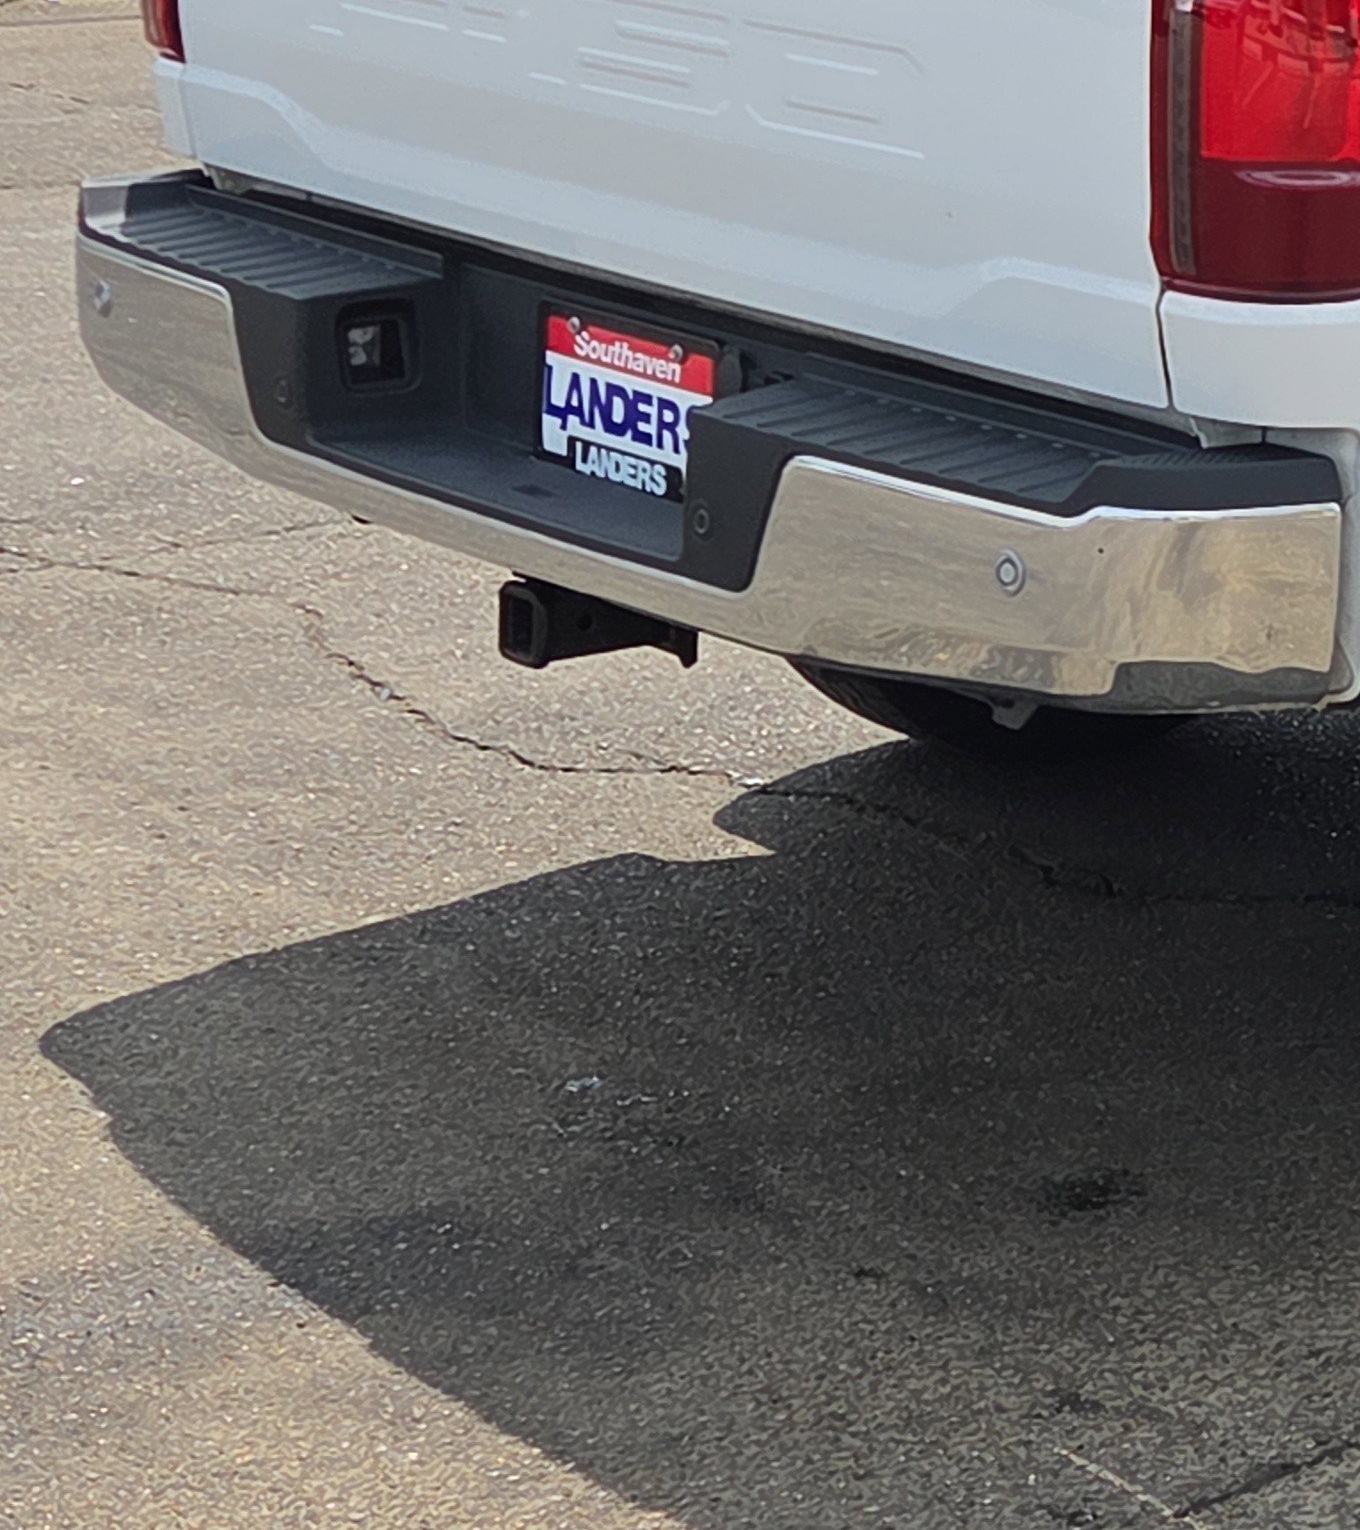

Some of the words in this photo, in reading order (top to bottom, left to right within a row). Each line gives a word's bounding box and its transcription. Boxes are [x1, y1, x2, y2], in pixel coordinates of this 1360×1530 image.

[574, 331, 681, 383] Southaven
[543, 365, 692, 455] LANDER
[575, 440, 667, 496] LANDERS
